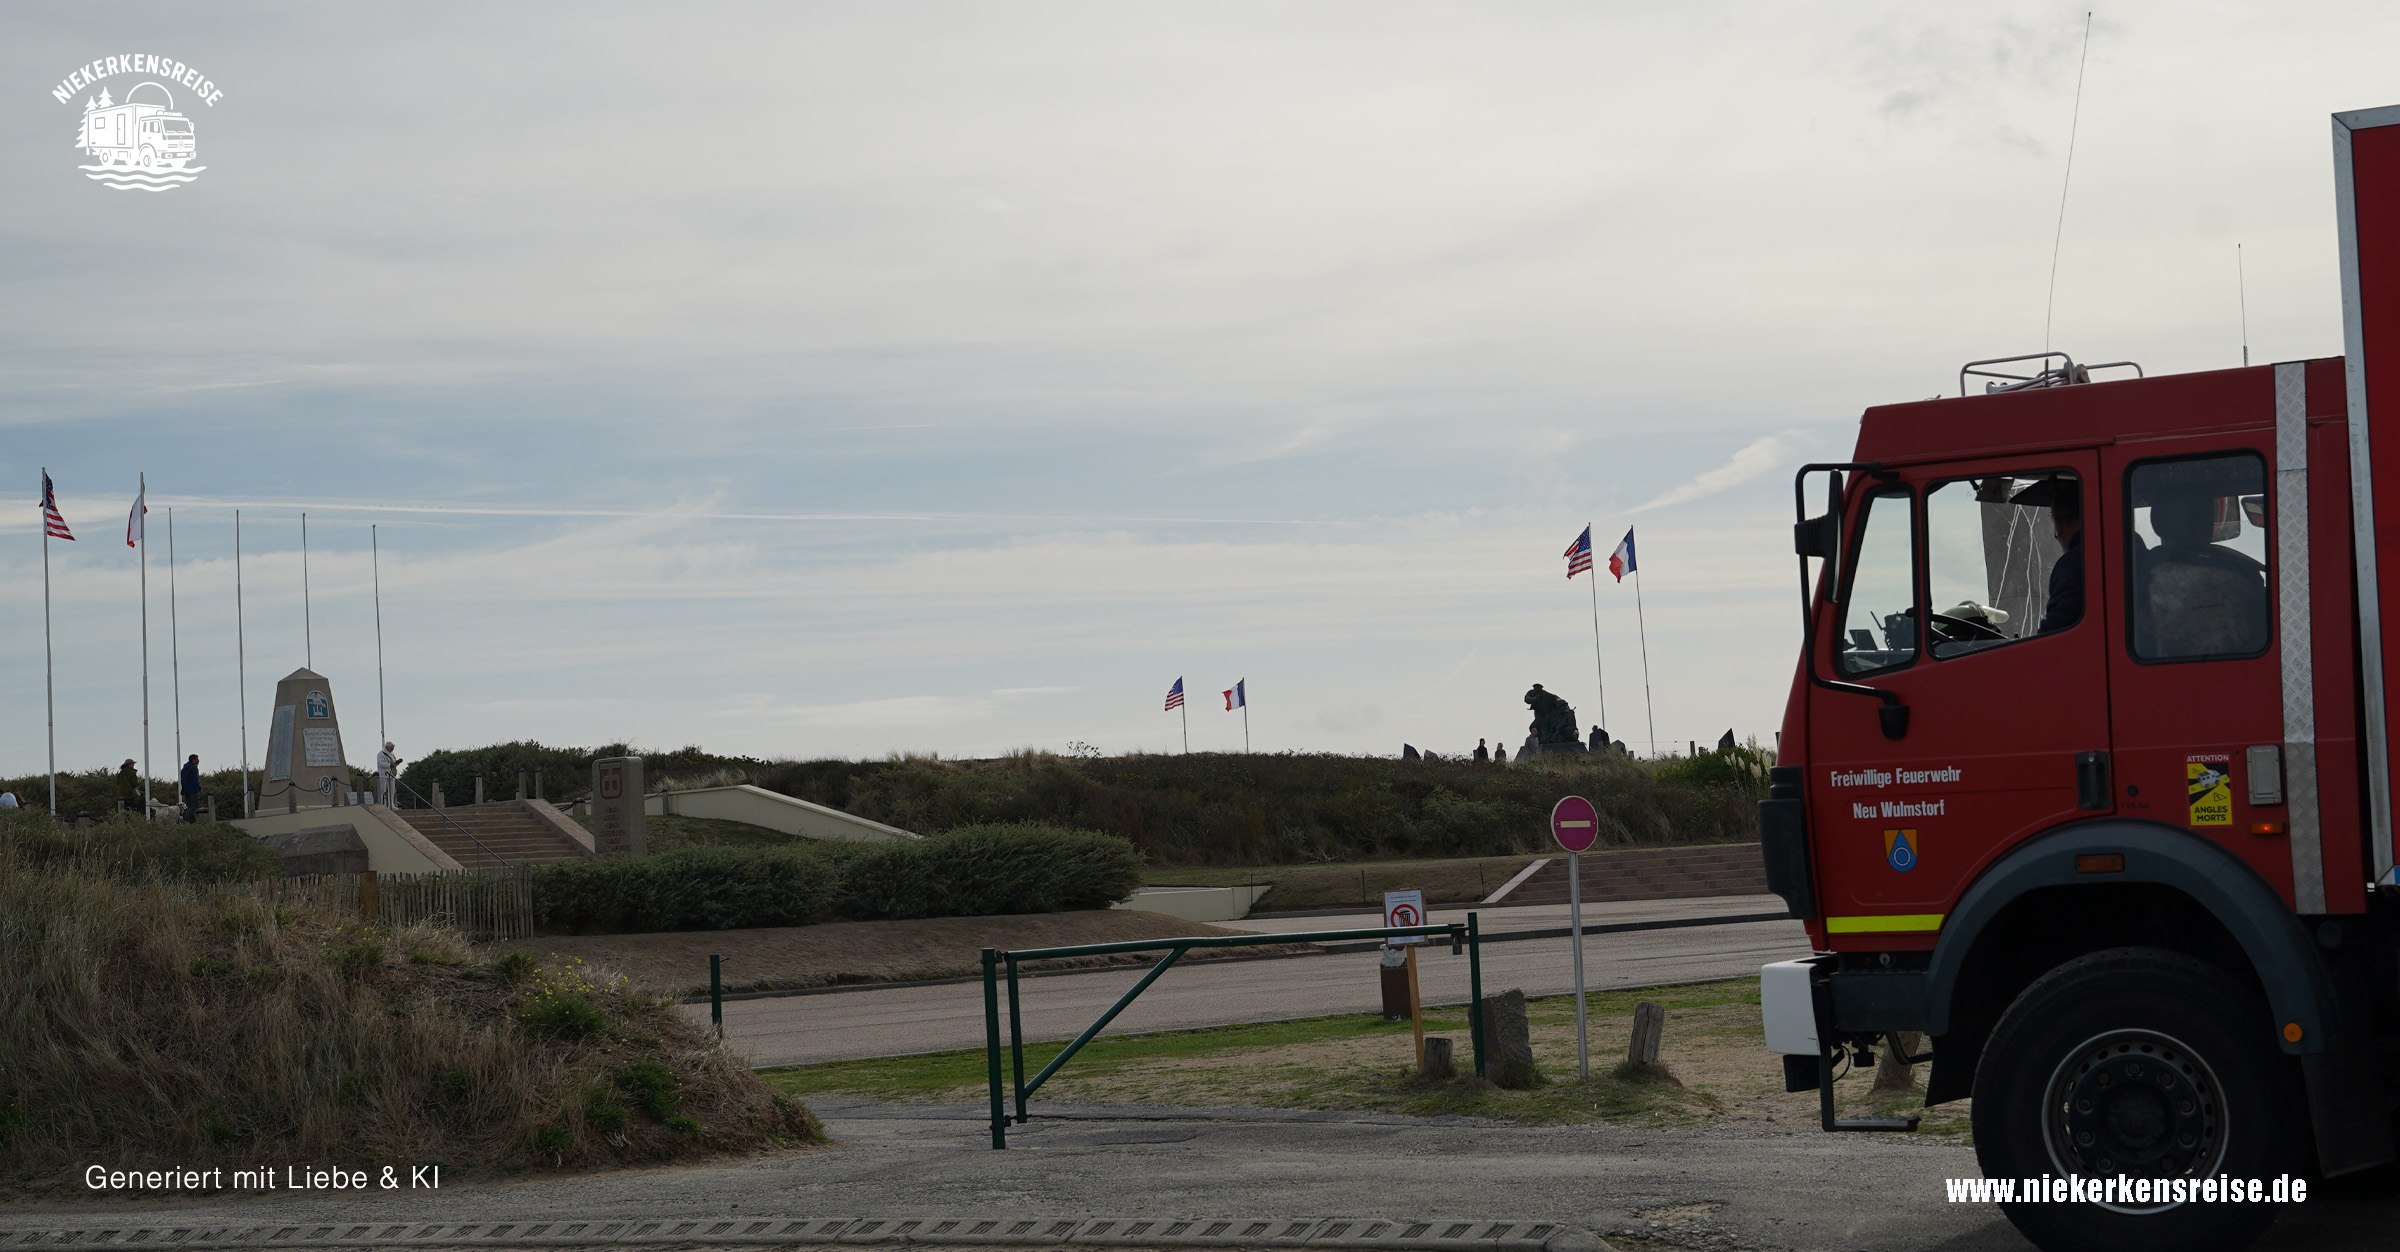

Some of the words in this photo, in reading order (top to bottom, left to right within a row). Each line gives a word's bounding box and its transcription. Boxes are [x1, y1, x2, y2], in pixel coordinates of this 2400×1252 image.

[1831, 769, 1892, 788] Freiwillige
[1896, 766, 1961, 784] Feuerwehr
[1853, 803, 1877, 819] Neu
[1881, 800, 1944, 818] Wulmstorf
